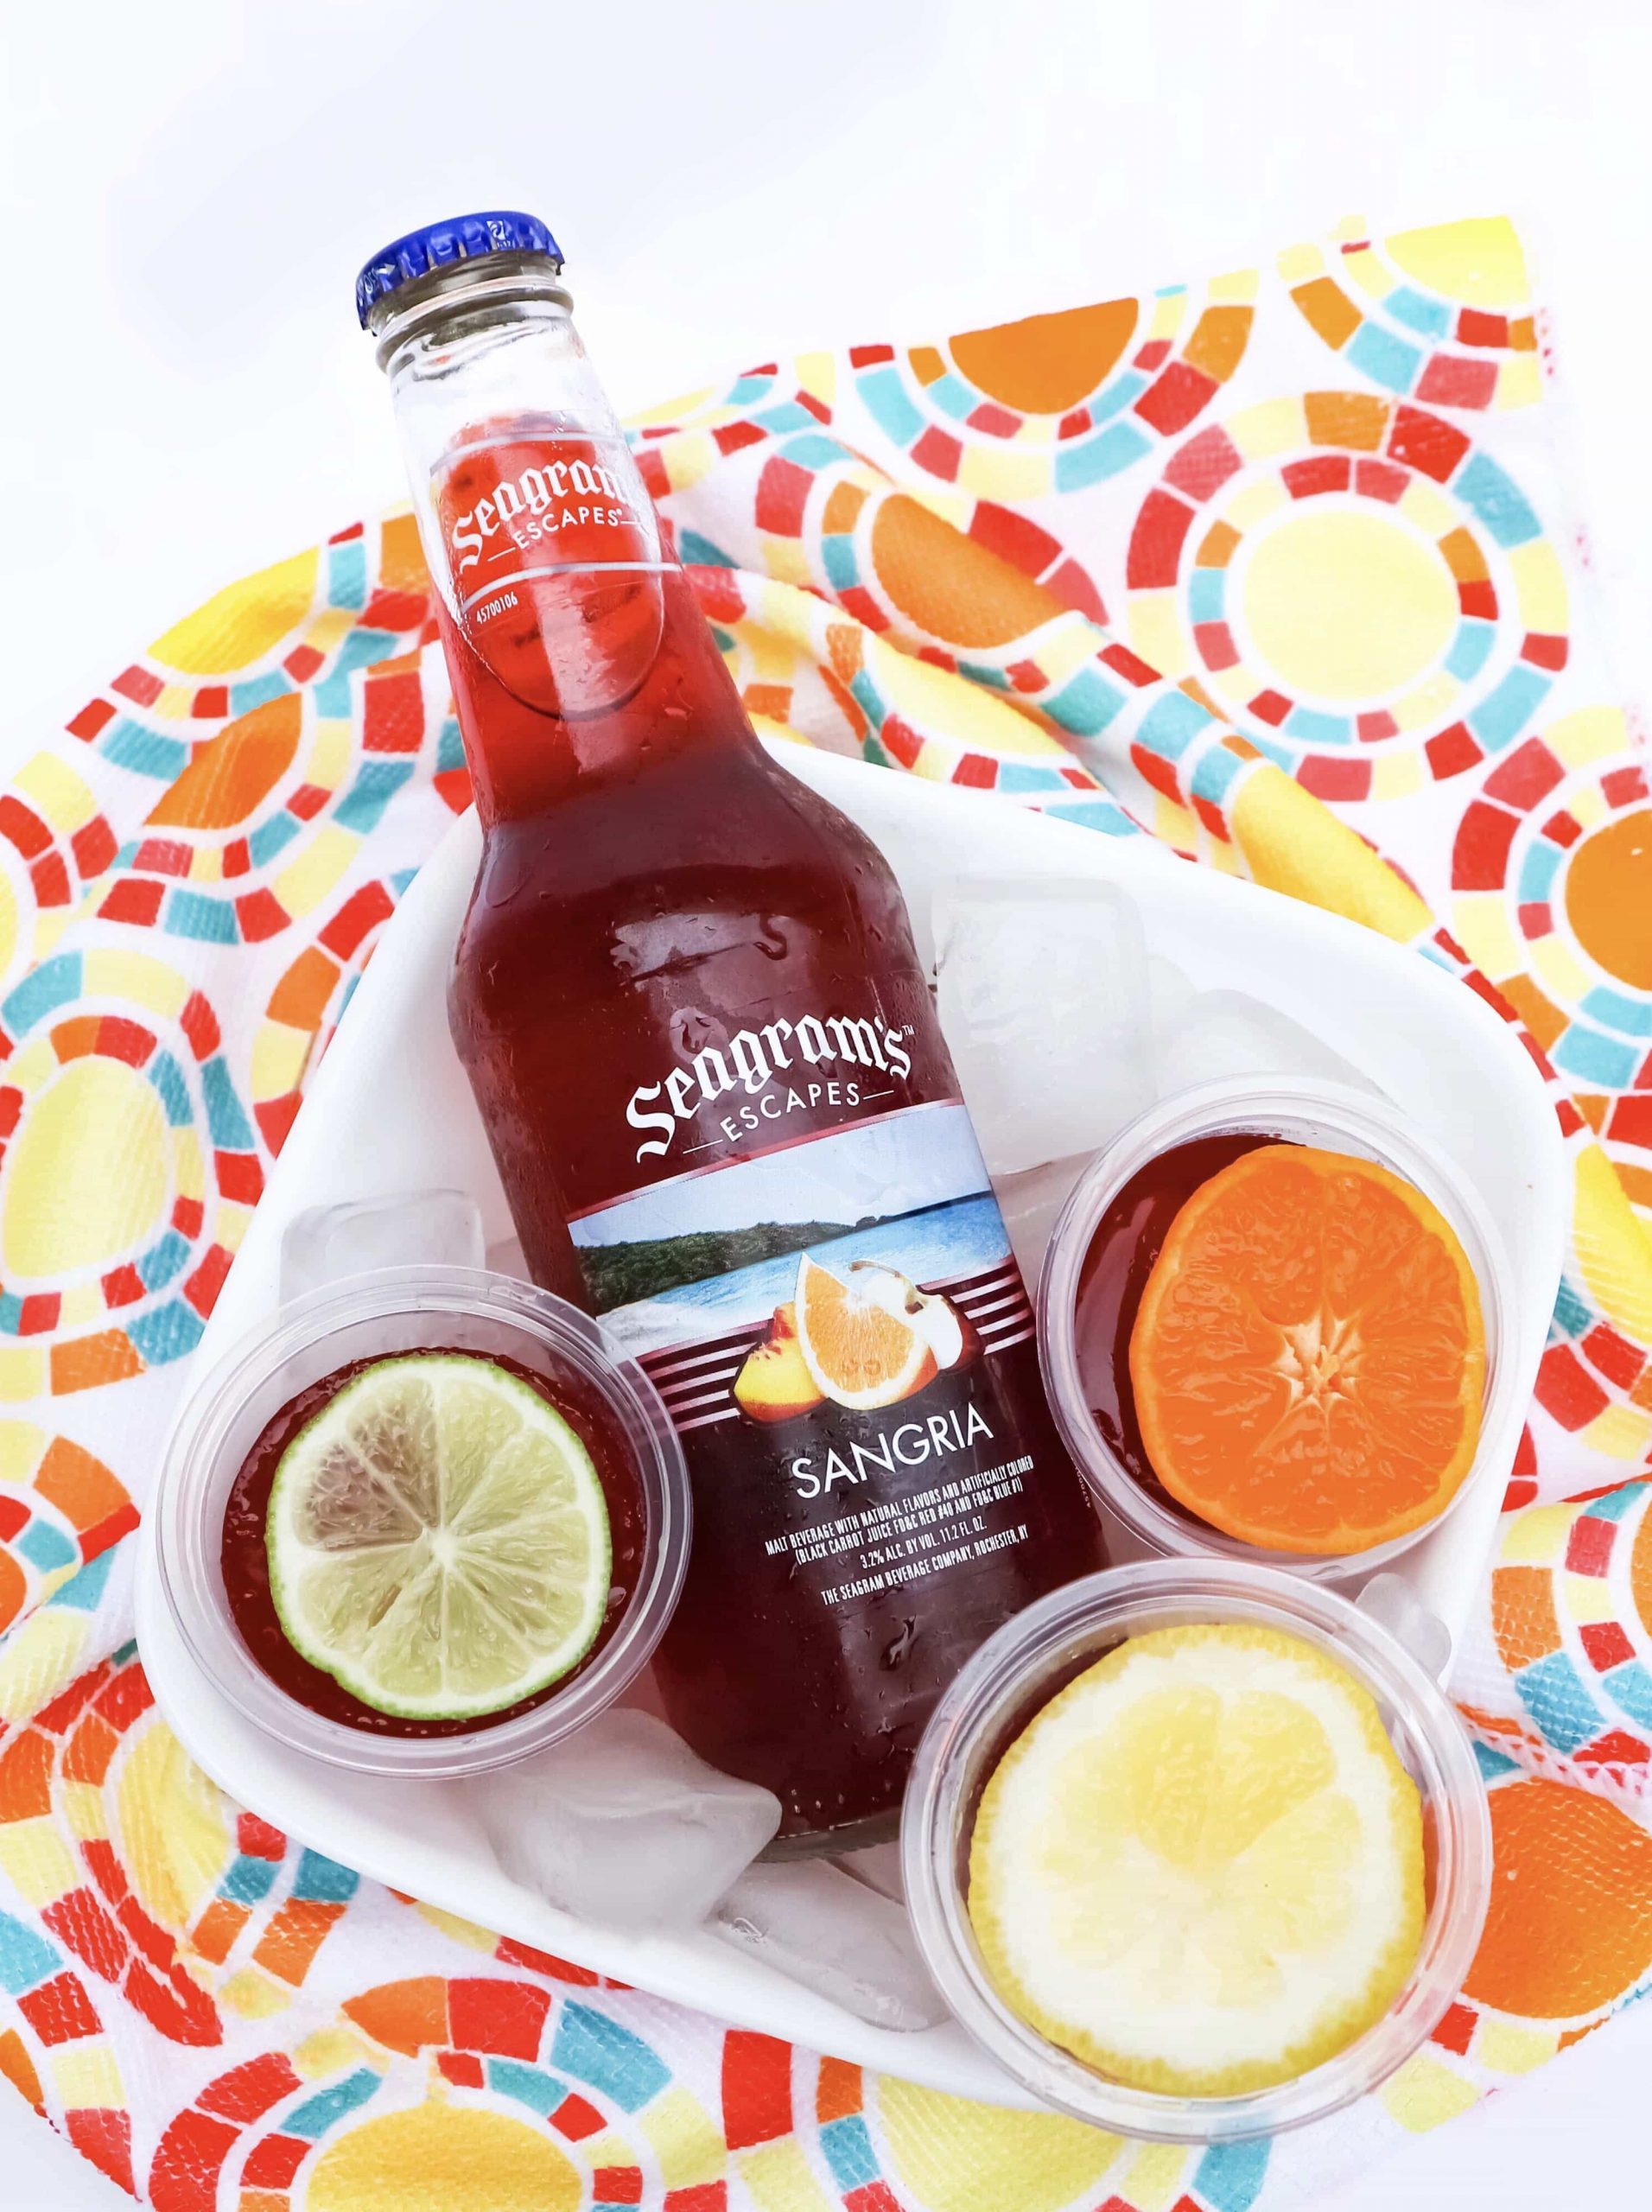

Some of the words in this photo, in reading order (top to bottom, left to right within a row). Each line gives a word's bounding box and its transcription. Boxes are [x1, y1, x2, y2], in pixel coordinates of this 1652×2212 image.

[452, 459, 634, 574] Seagram
[477, 591, 518, 624] 45700106
[720, 1082, 860, 1143] ESCAPES
[791, 1402, 994, 1499] SANGRIA
[765, 1536, 789, 1555] MALT
[789, 1522, 835, 1548] BEVERAGE
[835, 1515, 860, 1535] WITH
[860, 1502, 902, 1527] NATURAL
[902, 1488, 941, 1513] FLAVORS
[942, 1482, 960, 1501] AND
[960, 1465, 1007, 1494] ARTIFICIALLY
[1007, 1455, 1034, 1477] COLORED
[795, 1541, 829, 1566] (BLACK
[829, 1531, 864, 1554] CARROT
[867, 1522, 893, 1543] JUICE
[893, 1515, 918, 1535] FD&C
[918, 1508, 937, 1526] RED
[937, 1503, 954, 1520] #40
[954, 1496, 972, 1514] AND
[972, 1490, 994, 1508] FD&C
[994, 1480, 1013, 1500] BLUE
[1012, 1476, 1024, 1493] #1)
[860, 1549, 885, 1569] 3.2%
[885, 1543, 906, 1561] ALC.
[905, 1537, 920, 1554] BY
[918, 1532, 940, 1550] VOL.
[940, 1524, 959, 1543] 11.2
[959, 1521, 973, 1536] FL.
[972, 1516, 988, 1532] OZ.
[821, 1588, 841, 1605] THE
[840, 1573, 885, 1600] SEAGRAM
[885, 1560, 931, 1587] BEVERAGE
[931, 1544, 975, 1572] COMPANY,
[974, 1529, 1020, 1556] ROCHESTER,
[1018, 1524, 1029, 1541] NY
